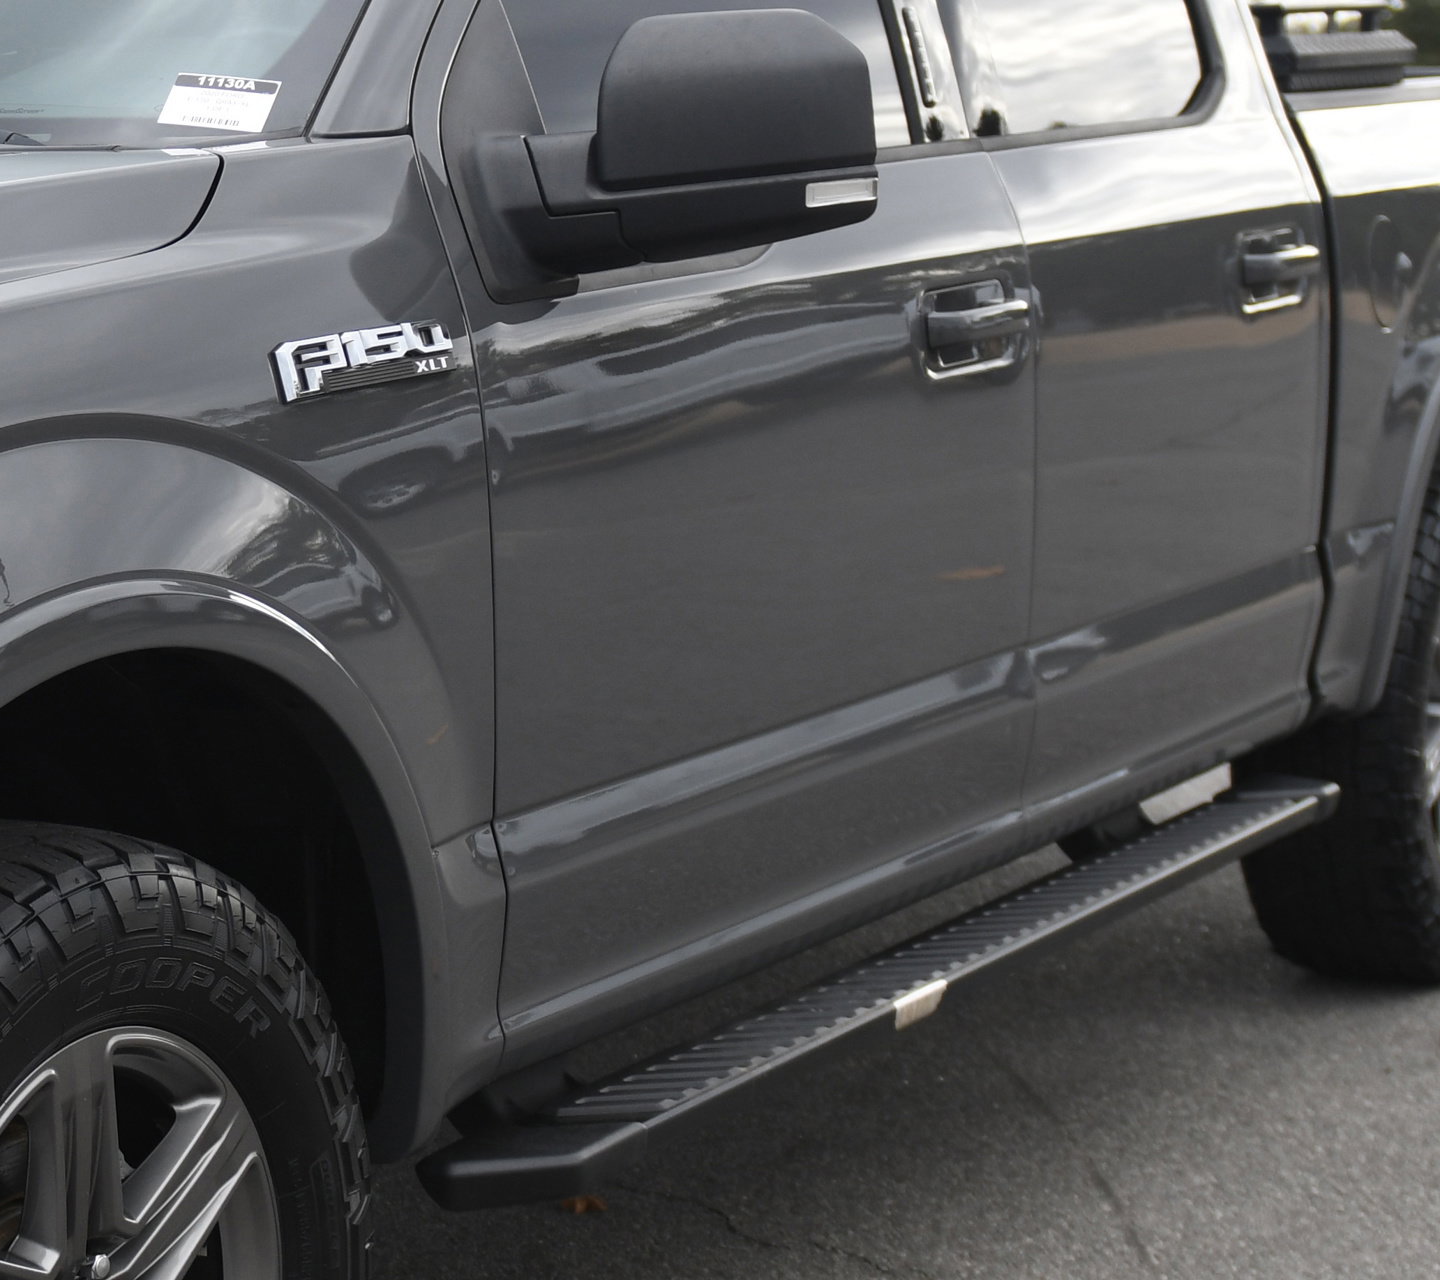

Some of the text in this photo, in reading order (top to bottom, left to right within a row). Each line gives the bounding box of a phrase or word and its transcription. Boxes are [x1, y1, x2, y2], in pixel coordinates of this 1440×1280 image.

[197, 75, 257, 91] 11130A
[414, 356, 450, 374] XLT
[76, 956, 272, 1039] COOPER
